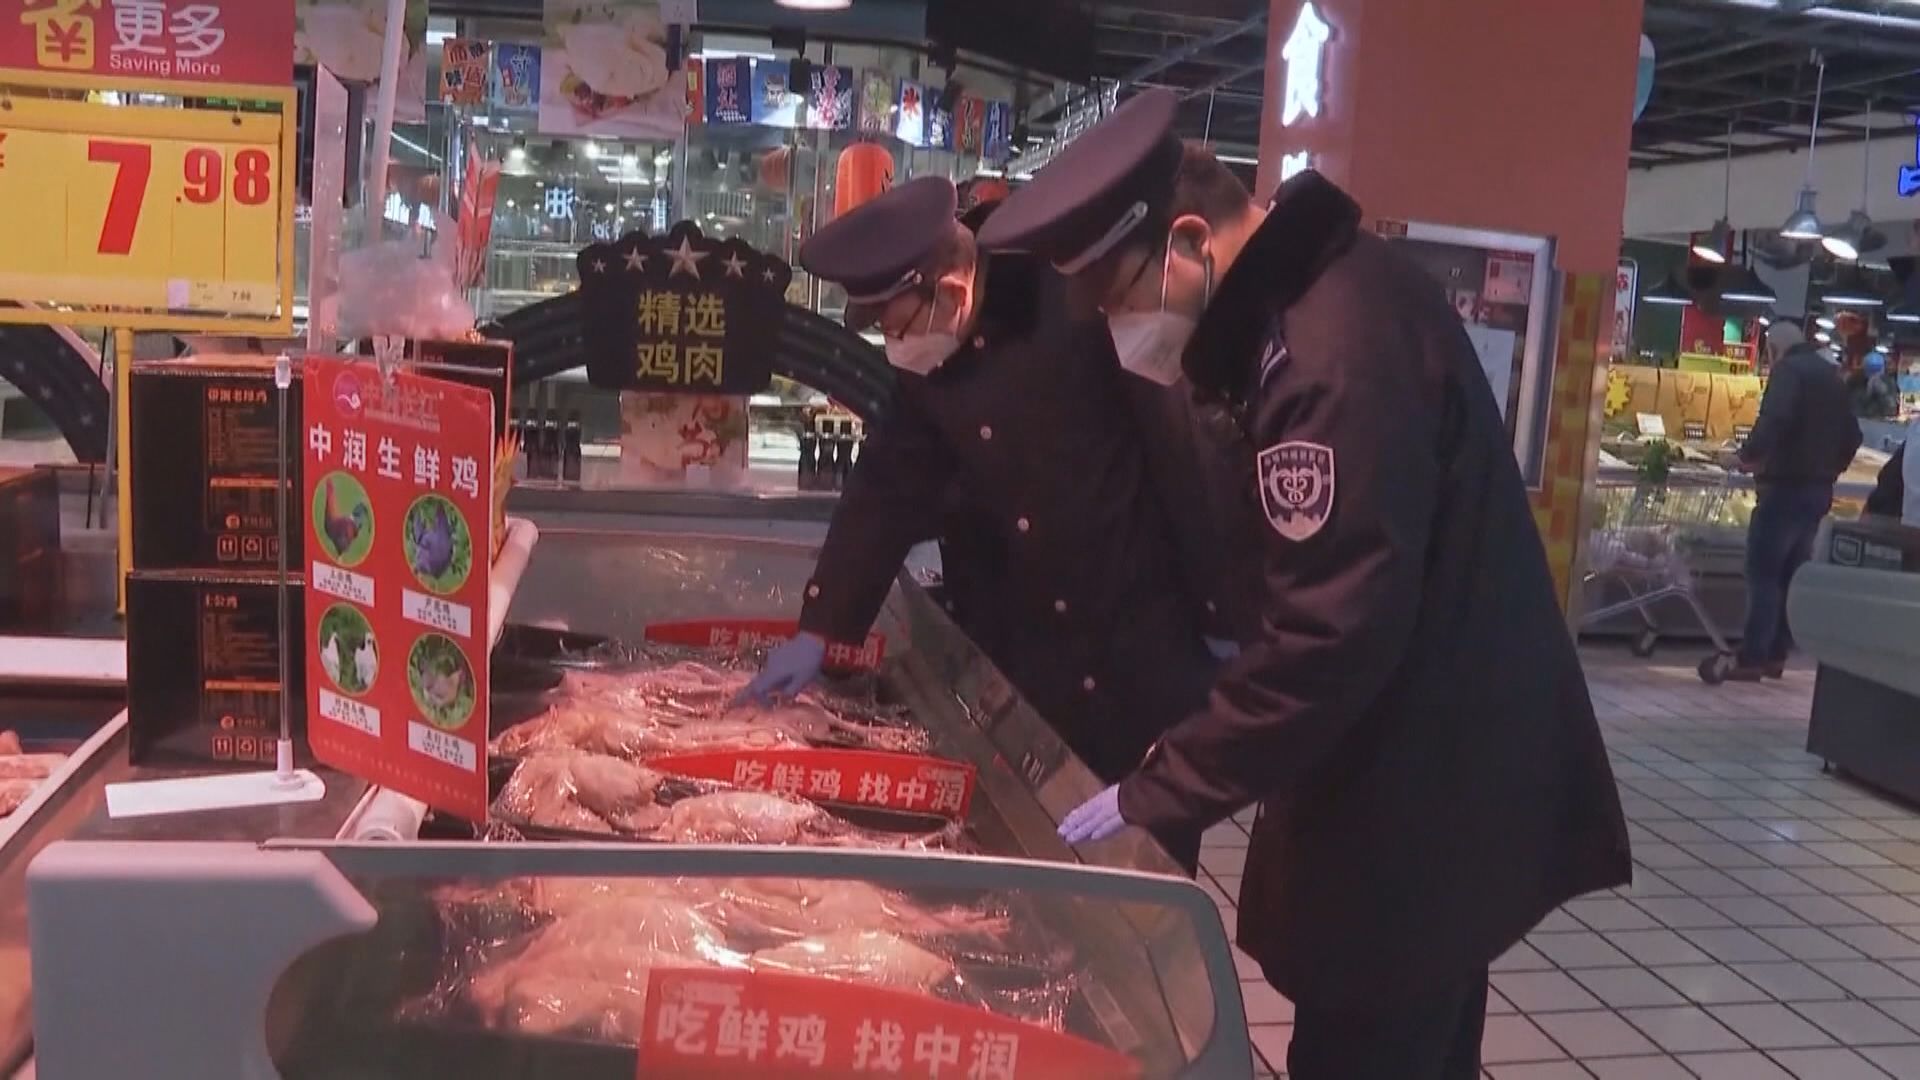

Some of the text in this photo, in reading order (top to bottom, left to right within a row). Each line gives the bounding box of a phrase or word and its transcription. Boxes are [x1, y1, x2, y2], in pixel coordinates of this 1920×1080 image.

[110, 54, 221, 76] Saving More
[88, 139, 271, 256] 7.98
[638, 288, 726, 336] 精选
[636, 340, 724, 385] 鸡肉
[309, 422, 479, 499] 中润生鲜鸡
[733, 760, 966, 812] 吃鲜鸡 找中润
[656, 1001, 1019, 1080] 吃鲜鸡 找中润
